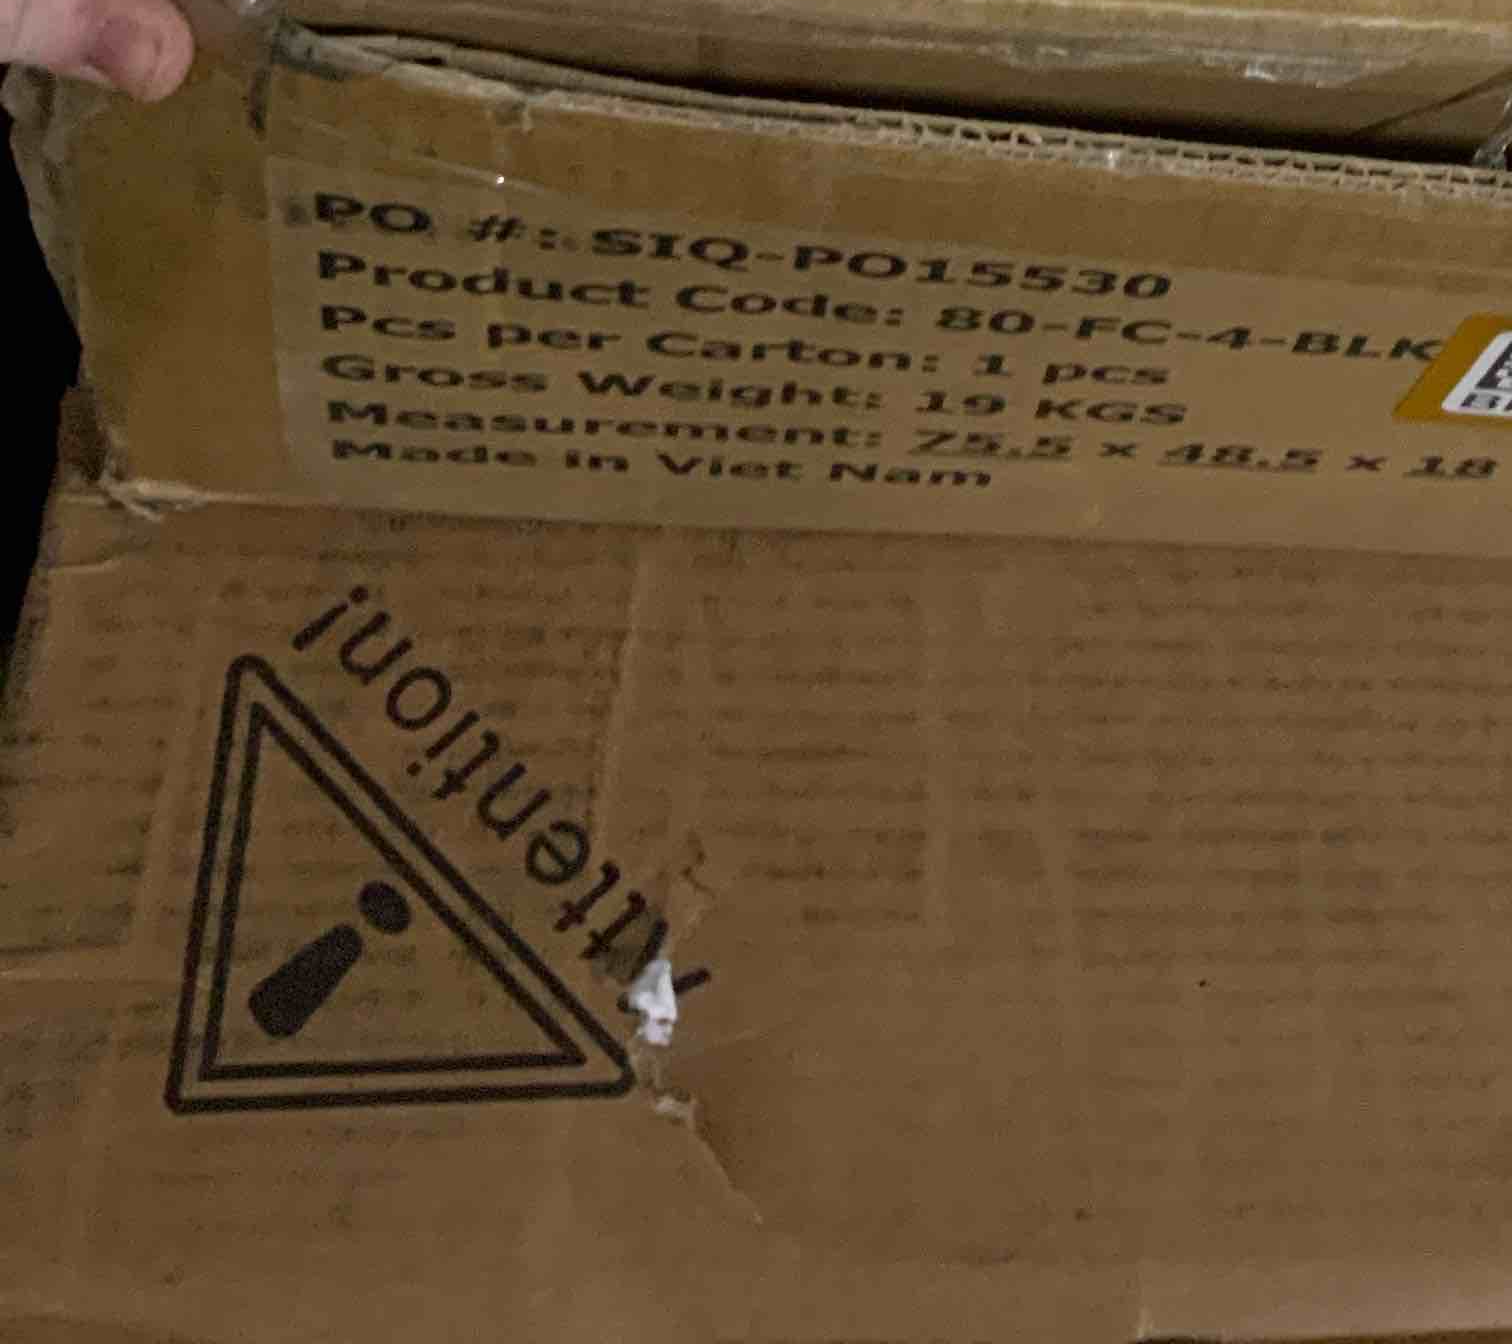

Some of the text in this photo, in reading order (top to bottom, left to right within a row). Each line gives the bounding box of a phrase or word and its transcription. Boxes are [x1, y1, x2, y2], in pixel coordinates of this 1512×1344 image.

[313, 192, 432, 238] PO
[590, 227, 1173, 302] SIQ-PO15530
[317, 250, 1443, 363] Product Code: 80-FC-4-BLK
[320, 304, 1170, 388] Pcs per Carton: 1 pcs
[320, 353, 1187, 427] Gross Weight: 19 KGS
[326, 399, 882, 452] Measurement:
[907, 427, 1074, 462] 75.5
[1098, 440, 1141, 461] x
[1160, 440, 1320, 473] 48.5
[1348, 454, 1389, 473] x
[1404, 454, 1498, 481] 18
[331, 438, 993, 489] Made in Viet Nam
[292, 587, 711, 1015] Attention!
